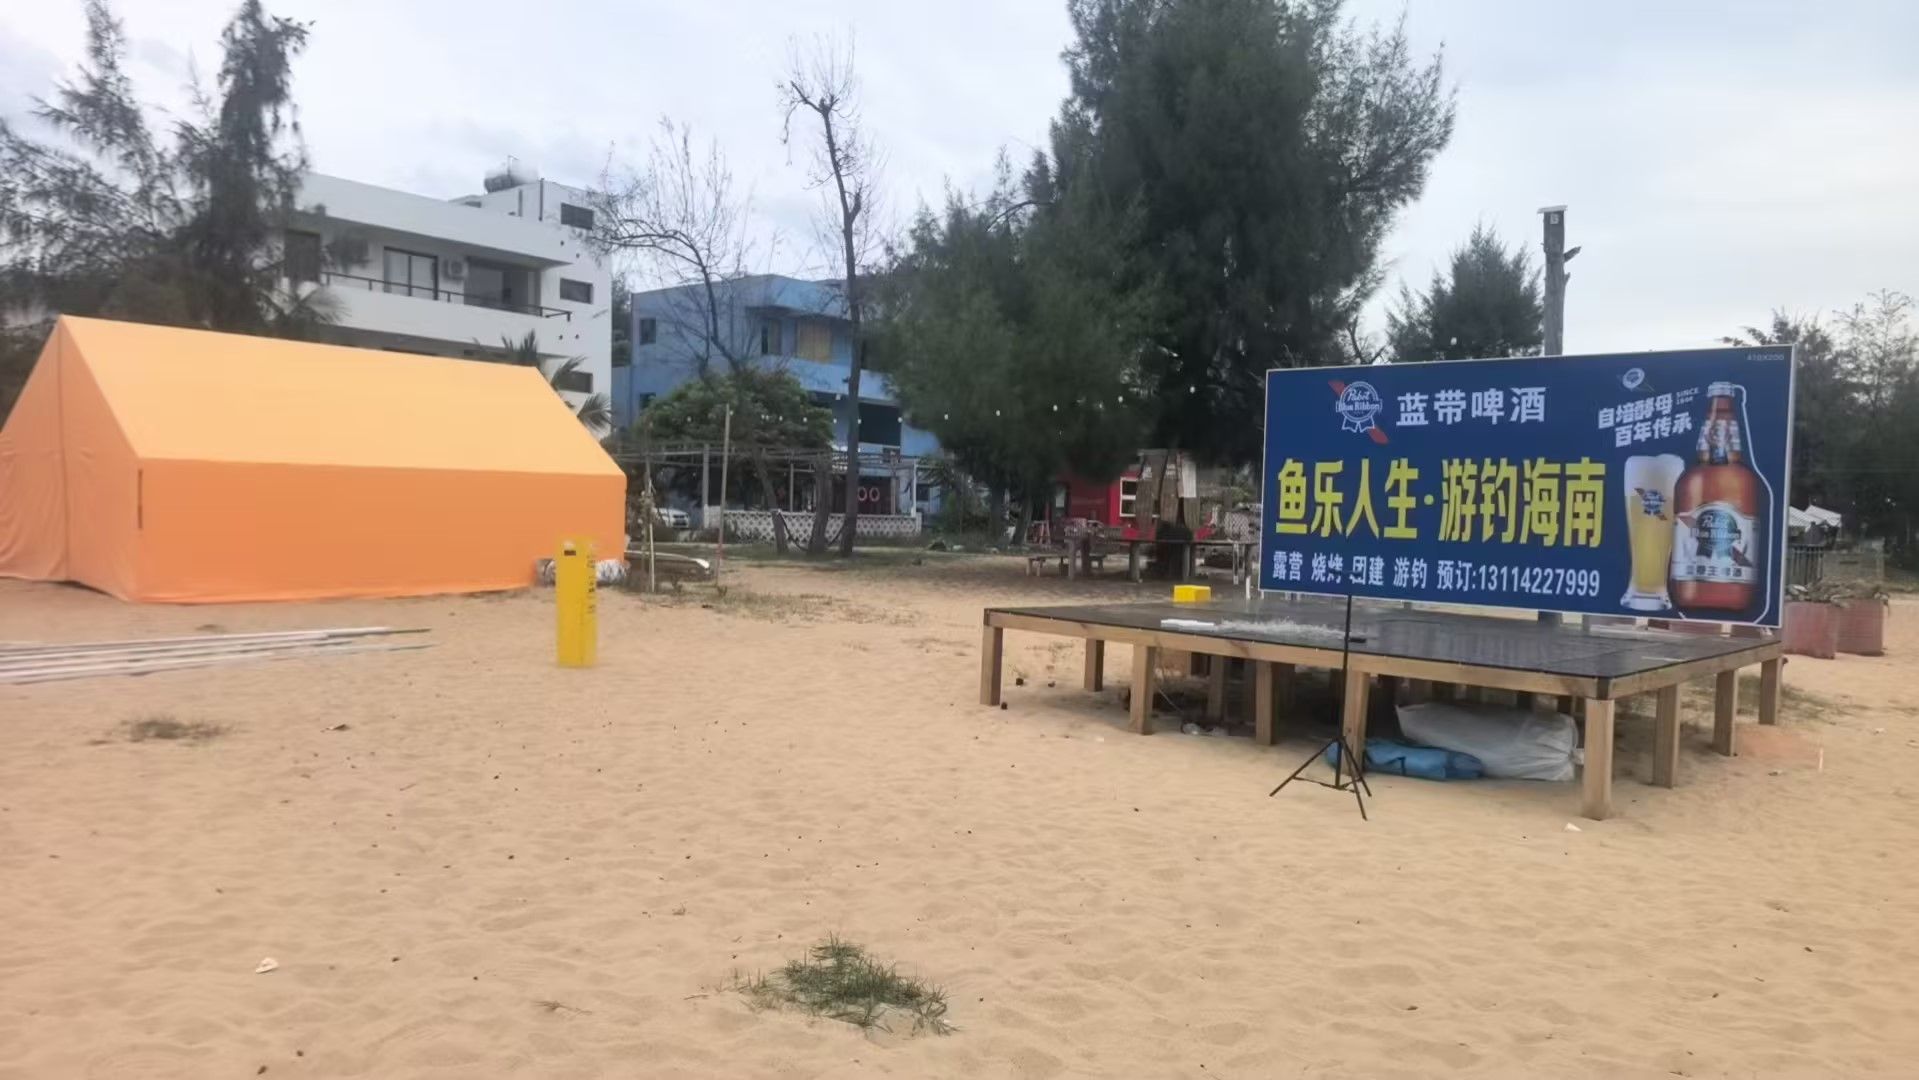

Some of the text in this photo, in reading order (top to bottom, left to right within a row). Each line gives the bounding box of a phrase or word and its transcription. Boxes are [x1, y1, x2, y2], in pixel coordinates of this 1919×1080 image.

[1396, 386, 1546, 426] 蓝带啤酒
[1598, 393, 1673, 429] 自培酵母
[1615, 412, 1692, 447] 百年传承
[1272, 551, 1303, 581] 露营
[1311, 552, 1343, 584] 烧烤
[1393, 556, 1427, 589] 游钓
[1437, 560, 1600, 597] 预订:13114227999
